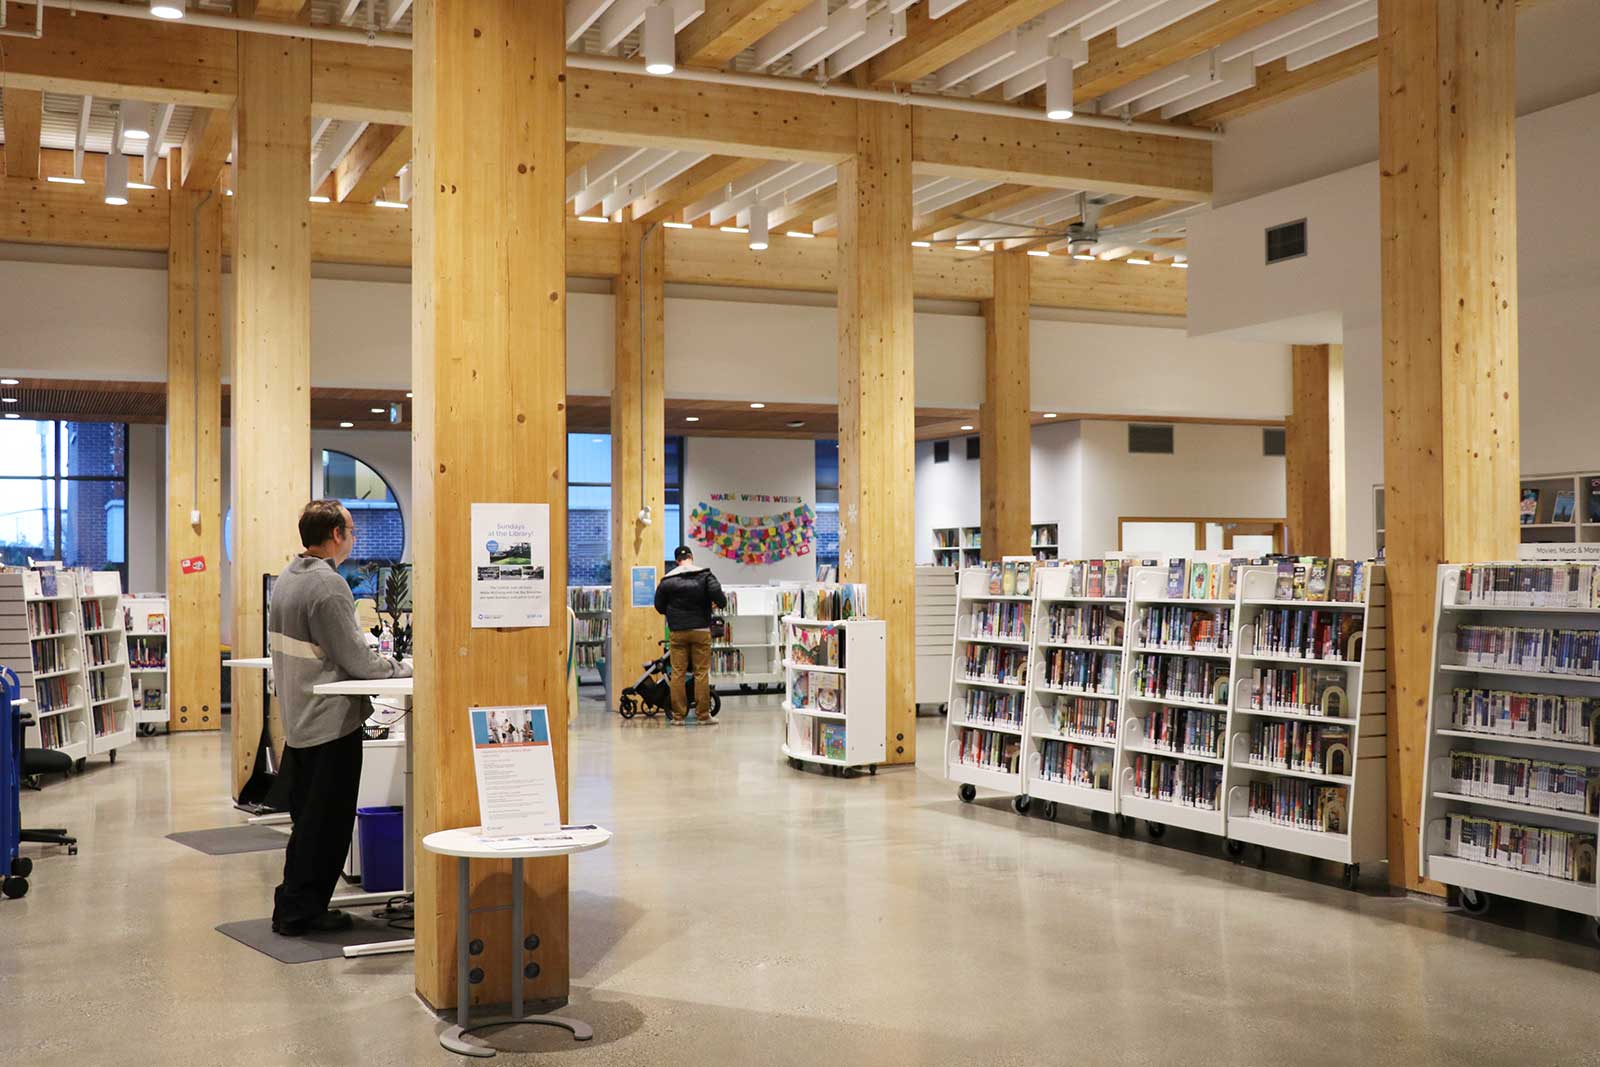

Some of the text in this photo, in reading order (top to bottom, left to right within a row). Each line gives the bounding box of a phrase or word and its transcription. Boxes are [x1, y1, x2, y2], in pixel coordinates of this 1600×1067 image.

[710, 493, 802, 503] WARM WINTER WISHES
